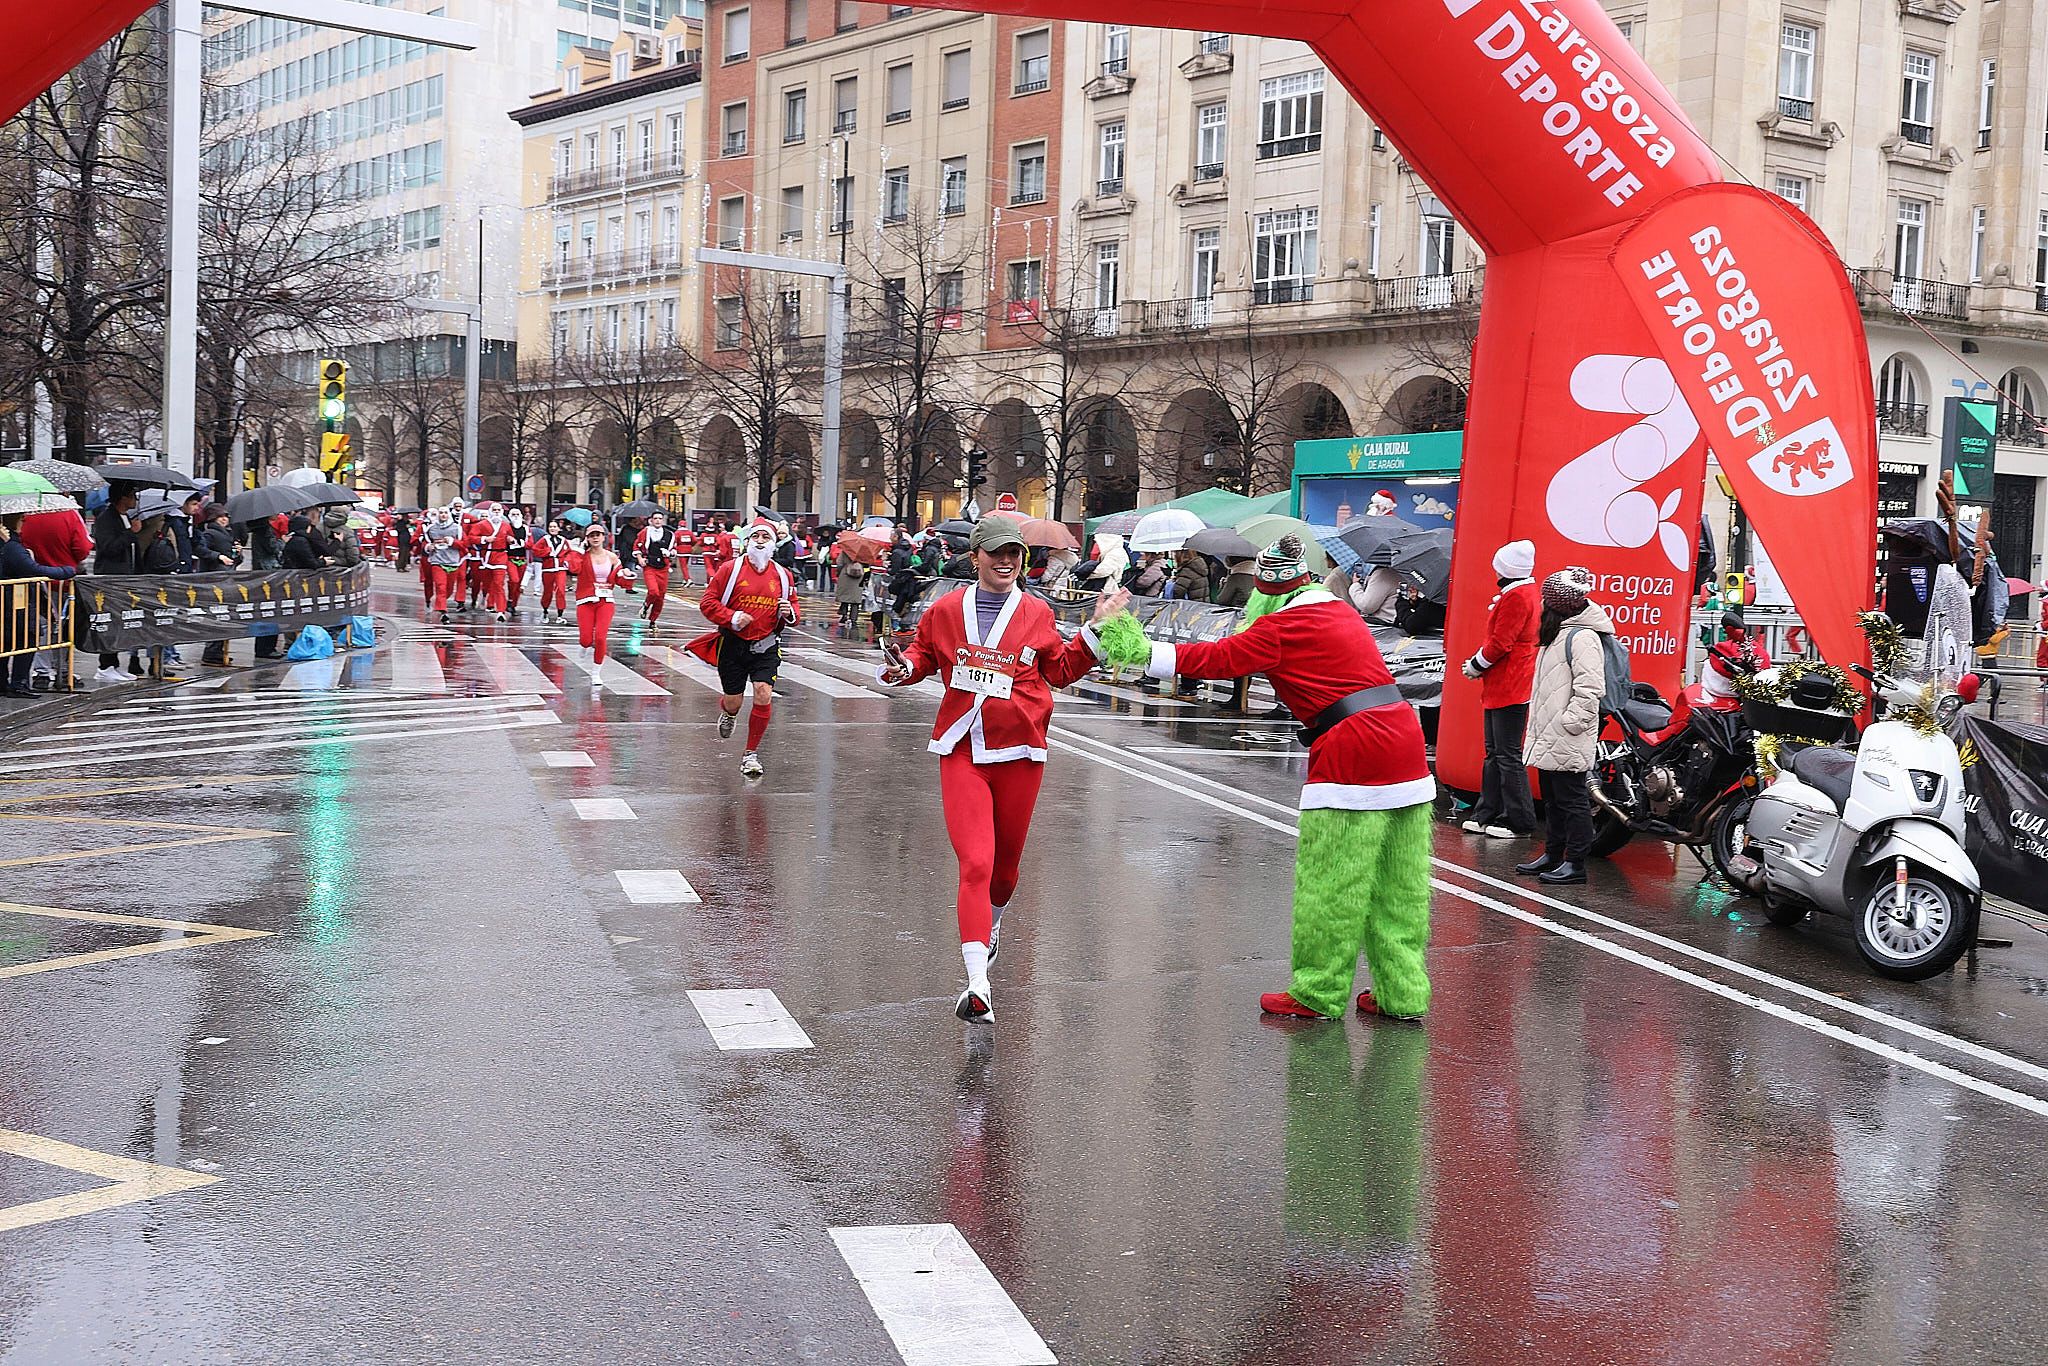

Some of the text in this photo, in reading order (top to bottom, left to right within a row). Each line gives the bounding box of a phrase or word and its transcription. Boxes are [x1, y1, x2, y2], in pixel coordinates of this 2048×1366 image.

[1473, 10, 1644, 208] DEPORTE
[1364, 441, 1411, 457] CAJA RURAL
[1367, 457, 1405, 470] DE ARAGÓN
[1878, 462, 1920, 475] SEPHORA
[999, 502, 1016, 510] STOP
[1566, 566, 1674, 600] aragoza
[1600, 602, 1662, 625] porte
[1619, 630, 1677, 655] enible
[968, 669, 994, 684] 1811
[2009, 809, 2047, 835] CAJA
